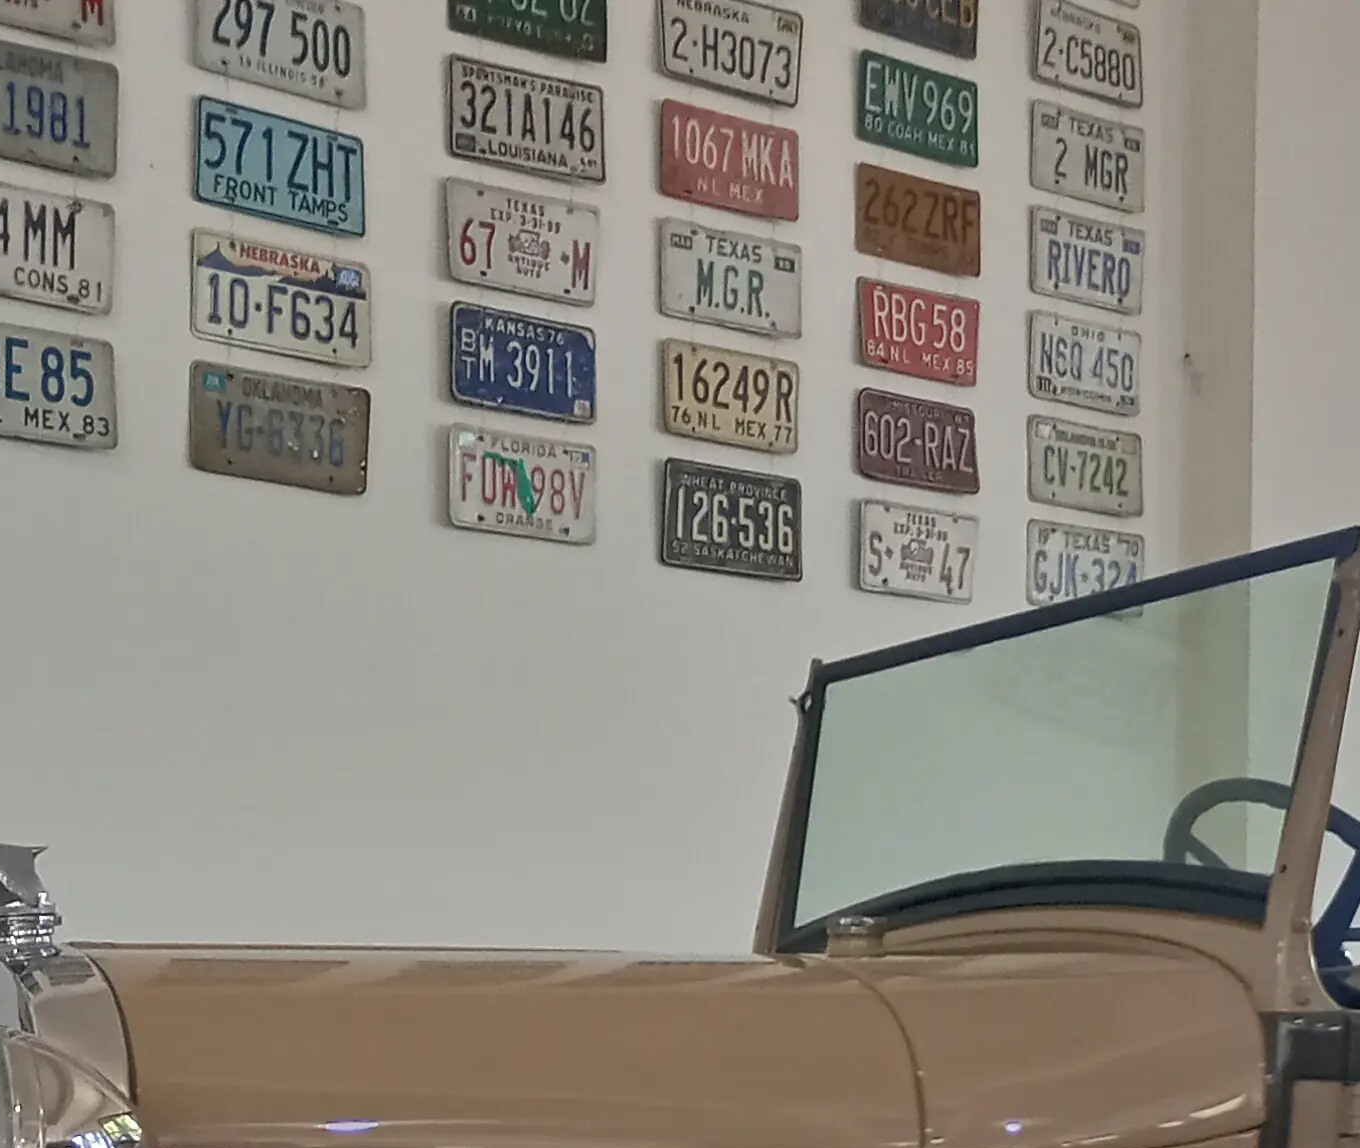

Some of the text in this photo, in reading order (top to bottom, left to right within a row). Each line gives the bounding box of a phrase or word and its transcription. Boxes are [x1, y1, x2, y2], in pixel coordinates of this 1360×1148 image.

[256, 61, 307, 84] ILLINOIS
[1069, 117, 1114, 144] TEXAS
[488, 139, 569, 168] LOUISIANA
[213, 174, 279, 206] FRONT
[506, 198, 545, 217] TEXAS
[1068, 221, 1114, 247] TEXAS
[238, 242, 321, 275] NEBRASKA
[705, 235, 763, 264] TEXAS
[1048, 239, 1131, 298] RIVERO
[484, 317, 544, 341] KANSAS
[1071, 326, 1106, 343] OHIO
[491, 437, 558, 459] FLORIDA
[864, 411, 974, 473] 602-RAZ
[730, 481, 787, 500] PROVINCE
[1063, 532, 1110, 553] TEXAS
[694, 544, 793, 567] SASKATCHEWAN
